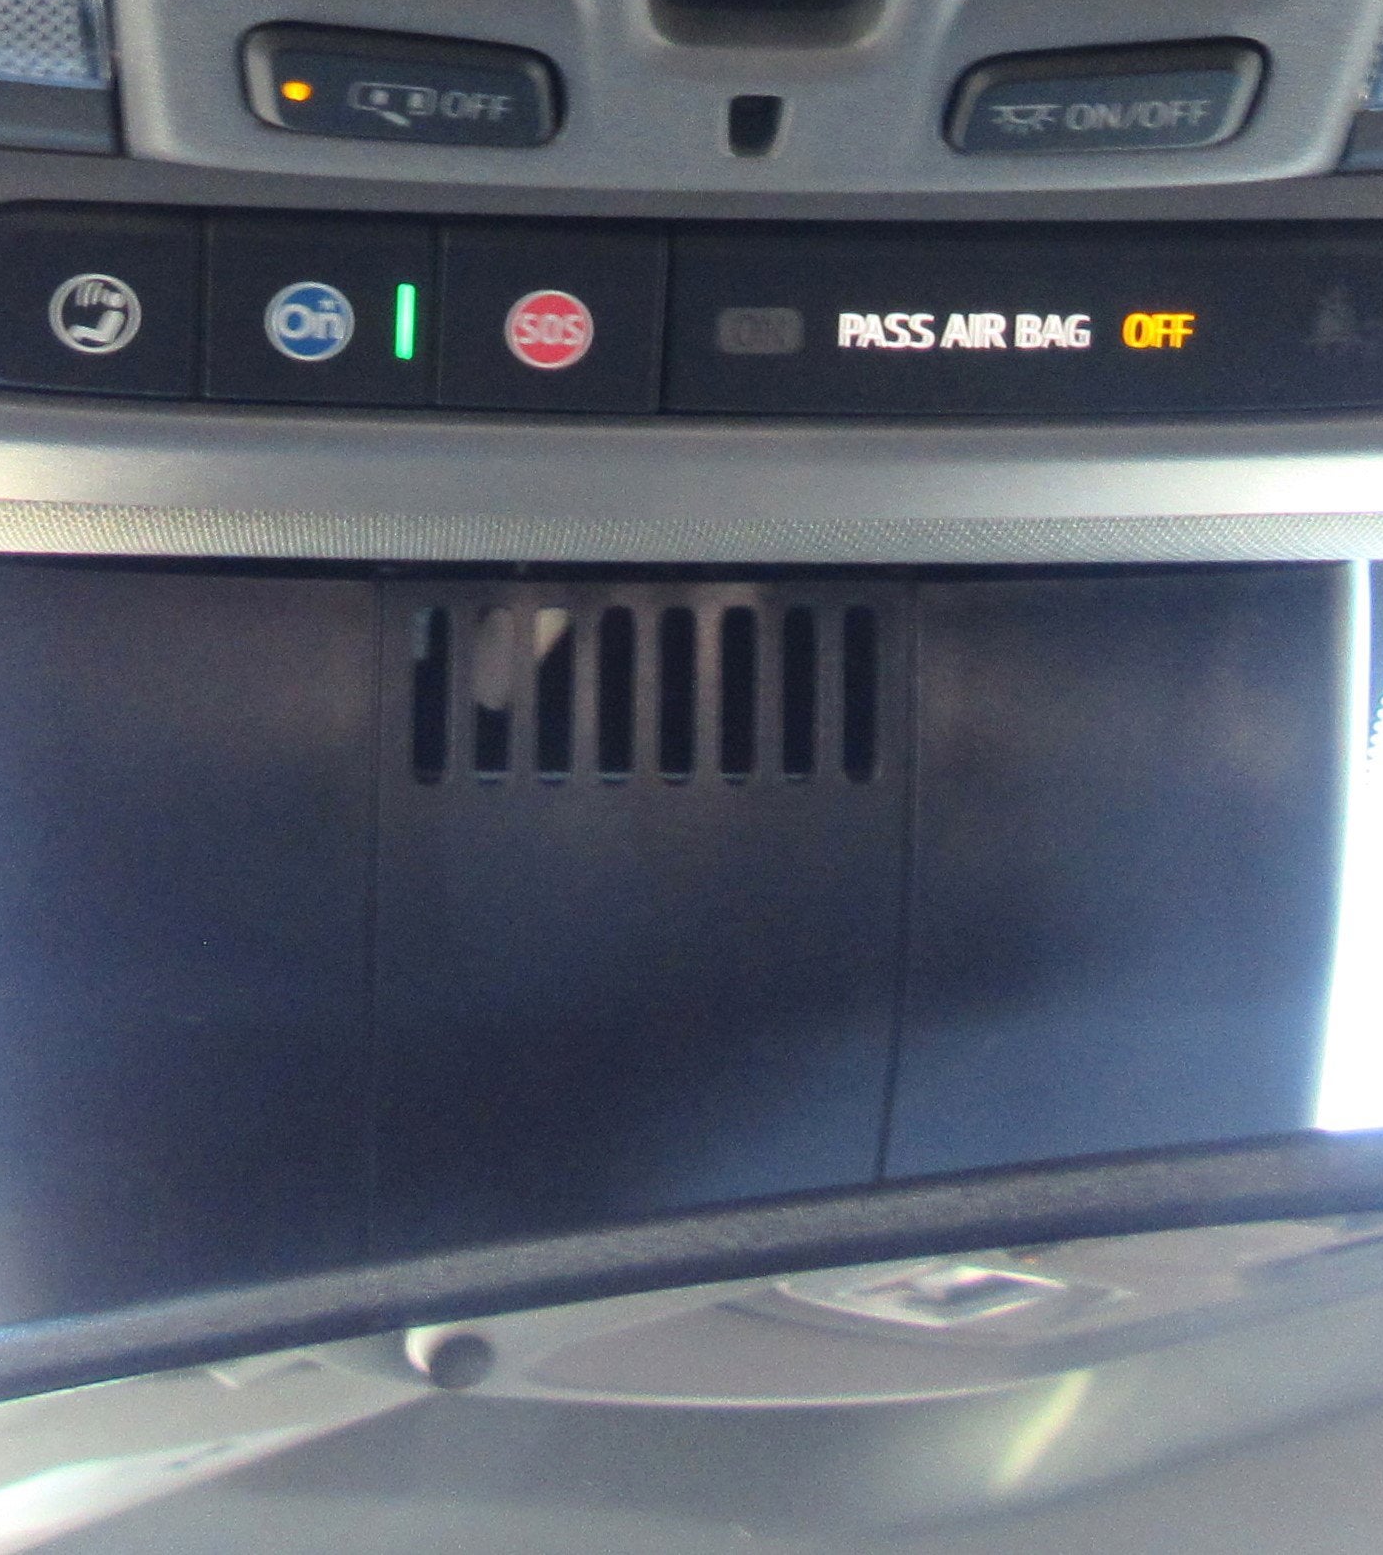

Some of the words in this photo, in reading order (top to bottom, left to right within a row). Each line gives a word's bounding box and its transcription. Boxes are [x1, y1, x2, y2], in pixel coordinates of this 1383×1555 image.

[441, 92, 515, 120] OFF
[1067, 99, 1211, 130] ON/OFF
[517, 312, 585, 346] SOS
[837, 312, 935, 349] PASS
[939, 312, 1008, 349] AIR
[1014, 312, 1092, 349] BAG
[1121, 312, 1196, 349] OFF
